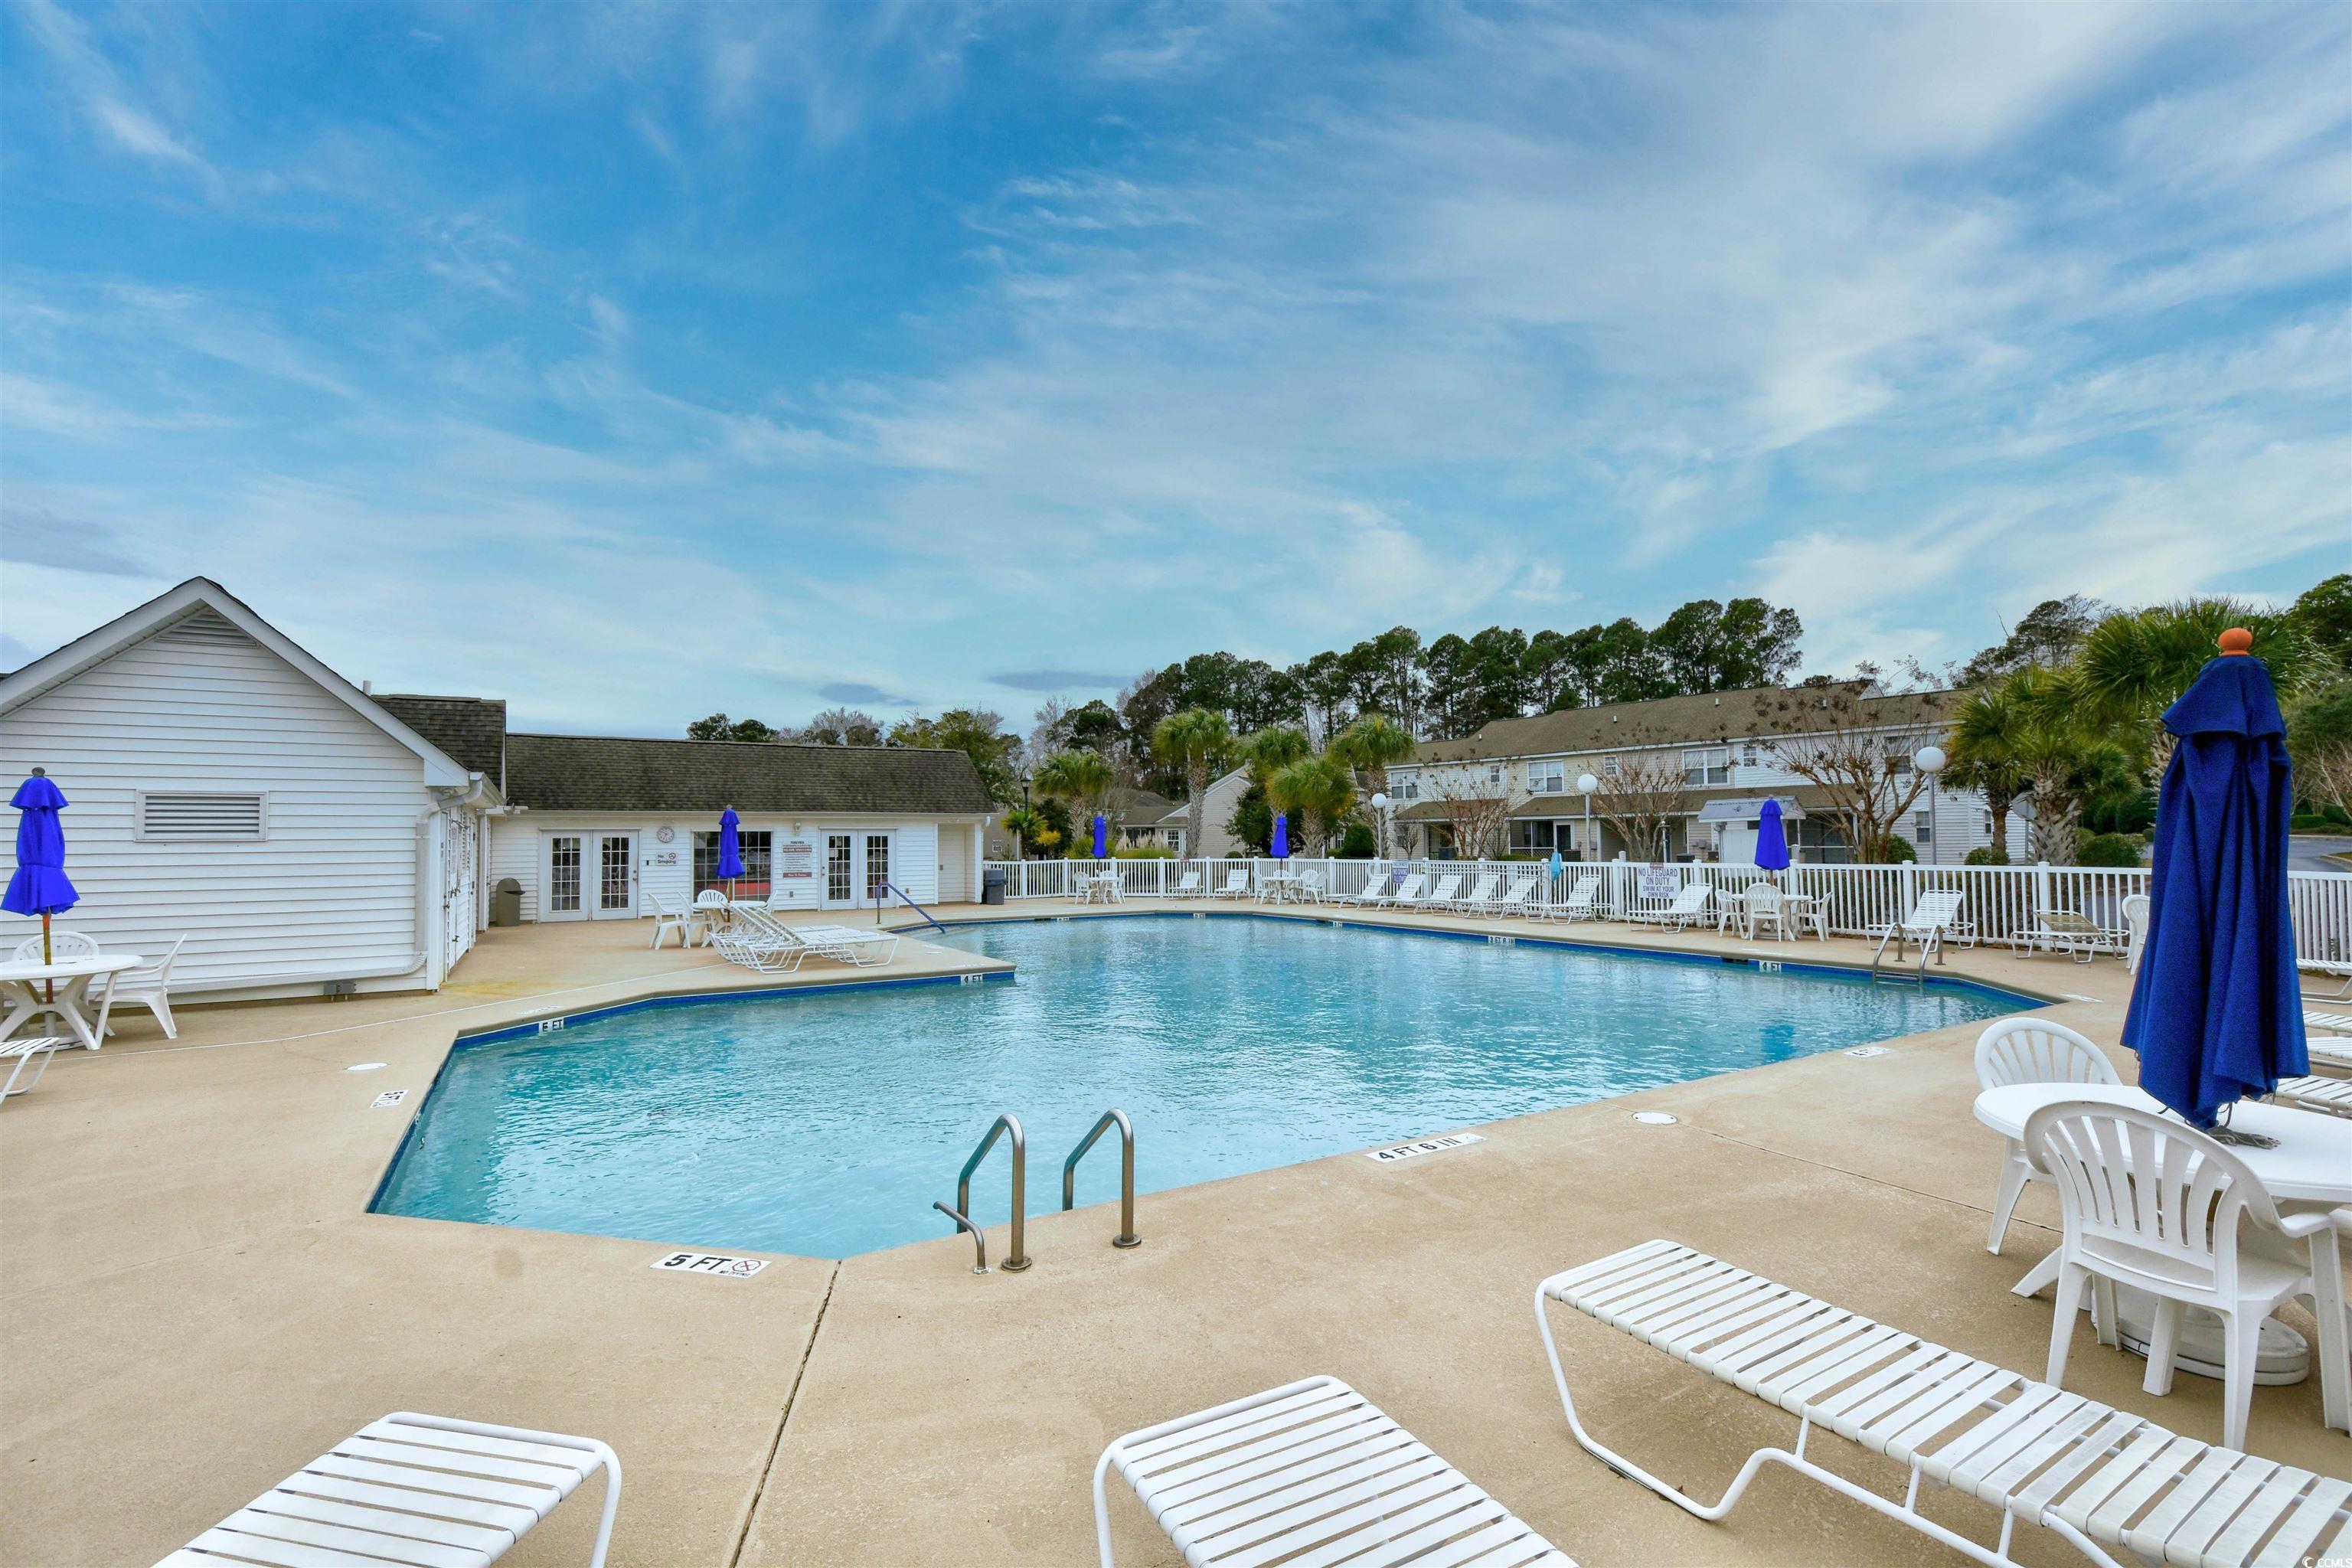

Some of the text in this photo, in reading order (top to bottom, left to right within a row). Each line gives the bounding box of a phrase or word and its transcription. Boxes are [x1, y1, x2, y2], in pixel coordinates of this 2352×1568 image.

[1638, 868, 1677, 877] NO LIFEGUARD
[1655, 877, 1670, 886] DUTY
[1379, 1152, 1395, 1160] 4
[1392, 1145, 1418, 1156] FT
[1436, 1137, 1462, 1147] IN
[664, 1254, 733, 1271] 5 FT
